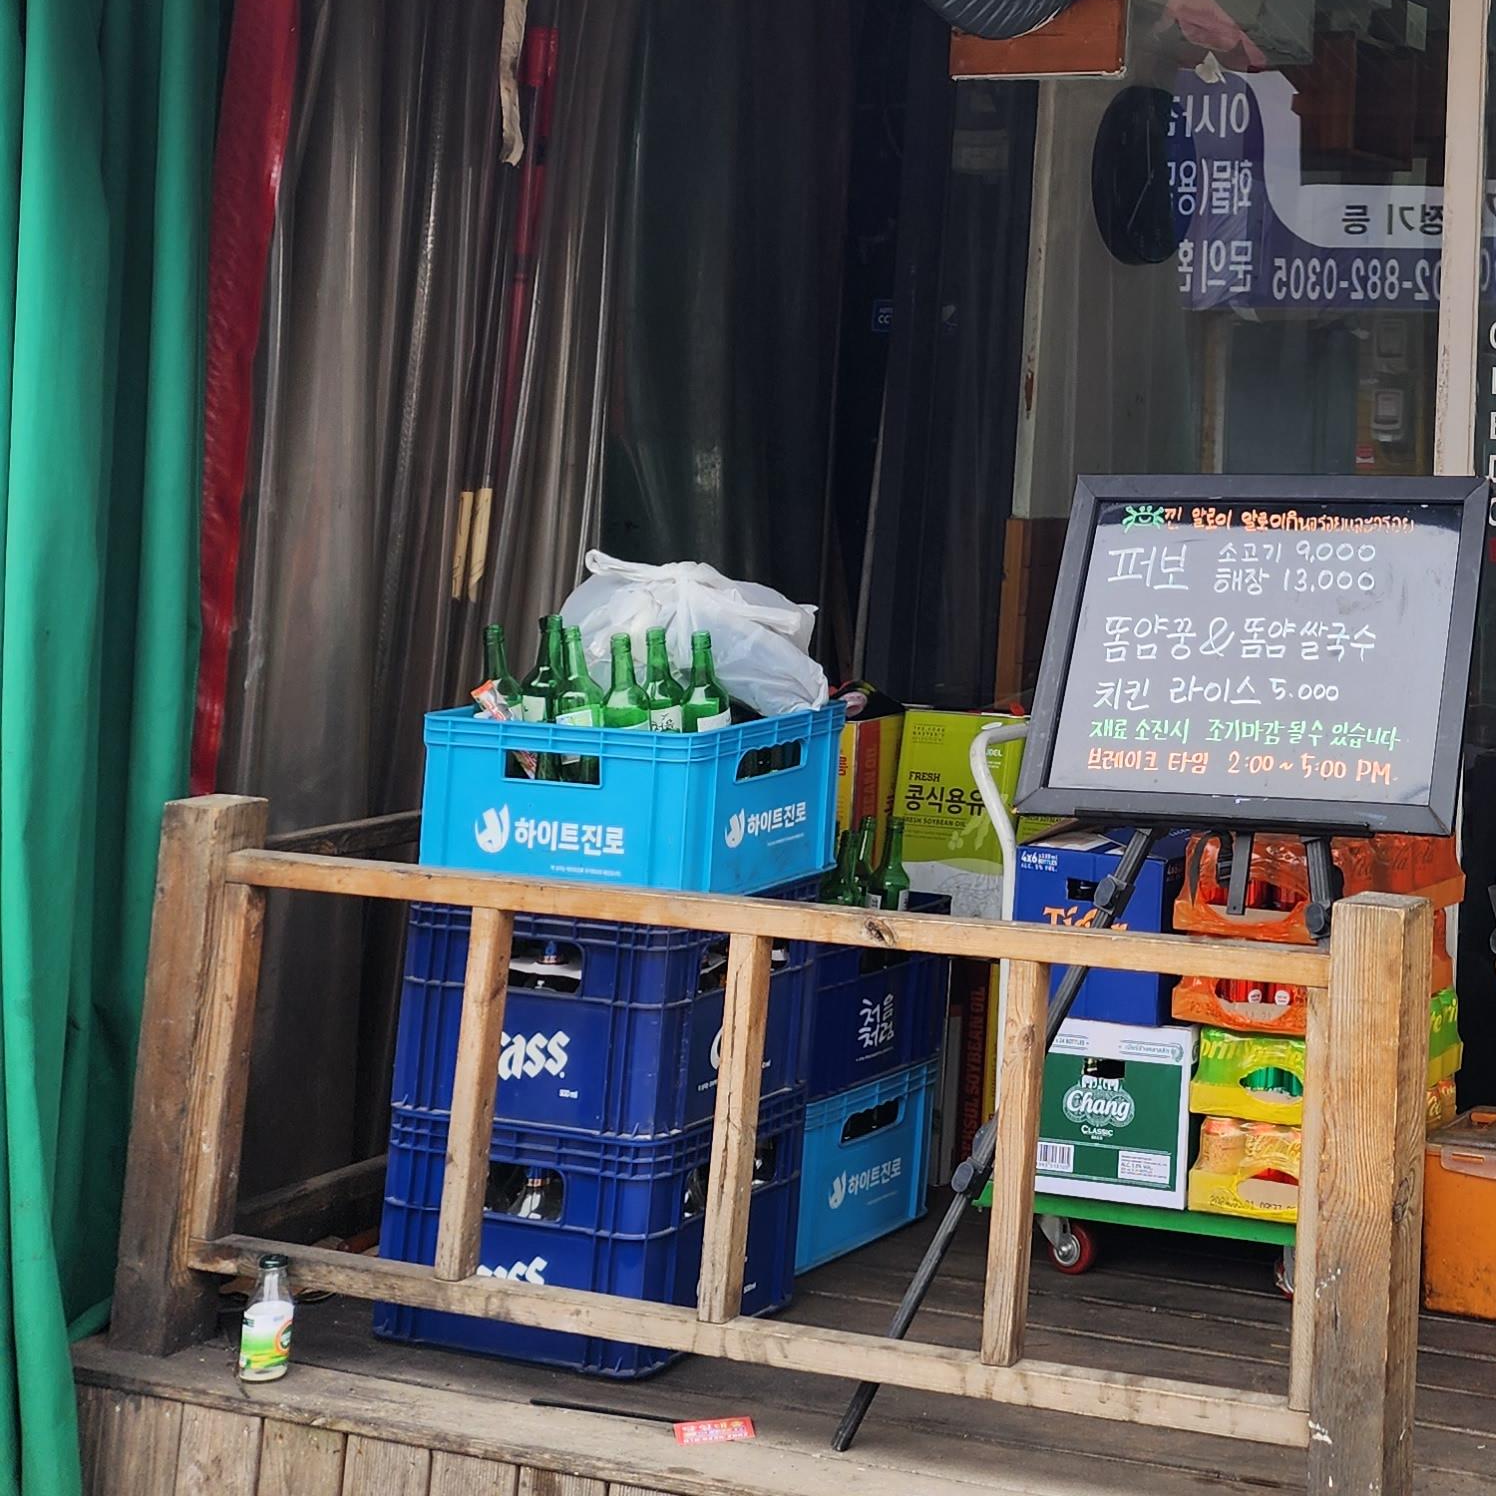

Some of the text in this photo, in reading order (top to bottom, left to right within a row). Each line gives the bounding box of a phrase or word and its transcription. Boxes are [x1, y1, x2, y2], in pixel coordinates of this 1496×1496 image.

[1192, 506, 1232, 531] 알로이
[1107, 545, 1189, 591] 퍼보
[1218, 542, 1281, 564] 소고기
[1214, 567, 1270, 595] 해장
[1199, 617, 1236, 658] &
[1093, 677, 1150, 711] 치킨
[1169, 676, 1262, 705] 라이스
[1089, 718, 1128, 739] 재료
[1135, 718, 1190, 744] 소진시
[1330, 722, 1401, 751] 있습니다
[908, 771, 941, 782] FRESH
[1087, 748, 1159, 771] 브레이크
[1168, 751, 1209, 774] 타임
[1356, 759, 1391, 785] PM
[904, 784, 986, 816] 콩식용유
[747, 801, 806, 836] 하이트진로
[514, 817, 625, 856] 하이트진로
[498, 1030, 566, 1080] ass
[1066, 1090, 1131, 1121] Chang
[848, 1157, 901, 1196] 하이트진로
